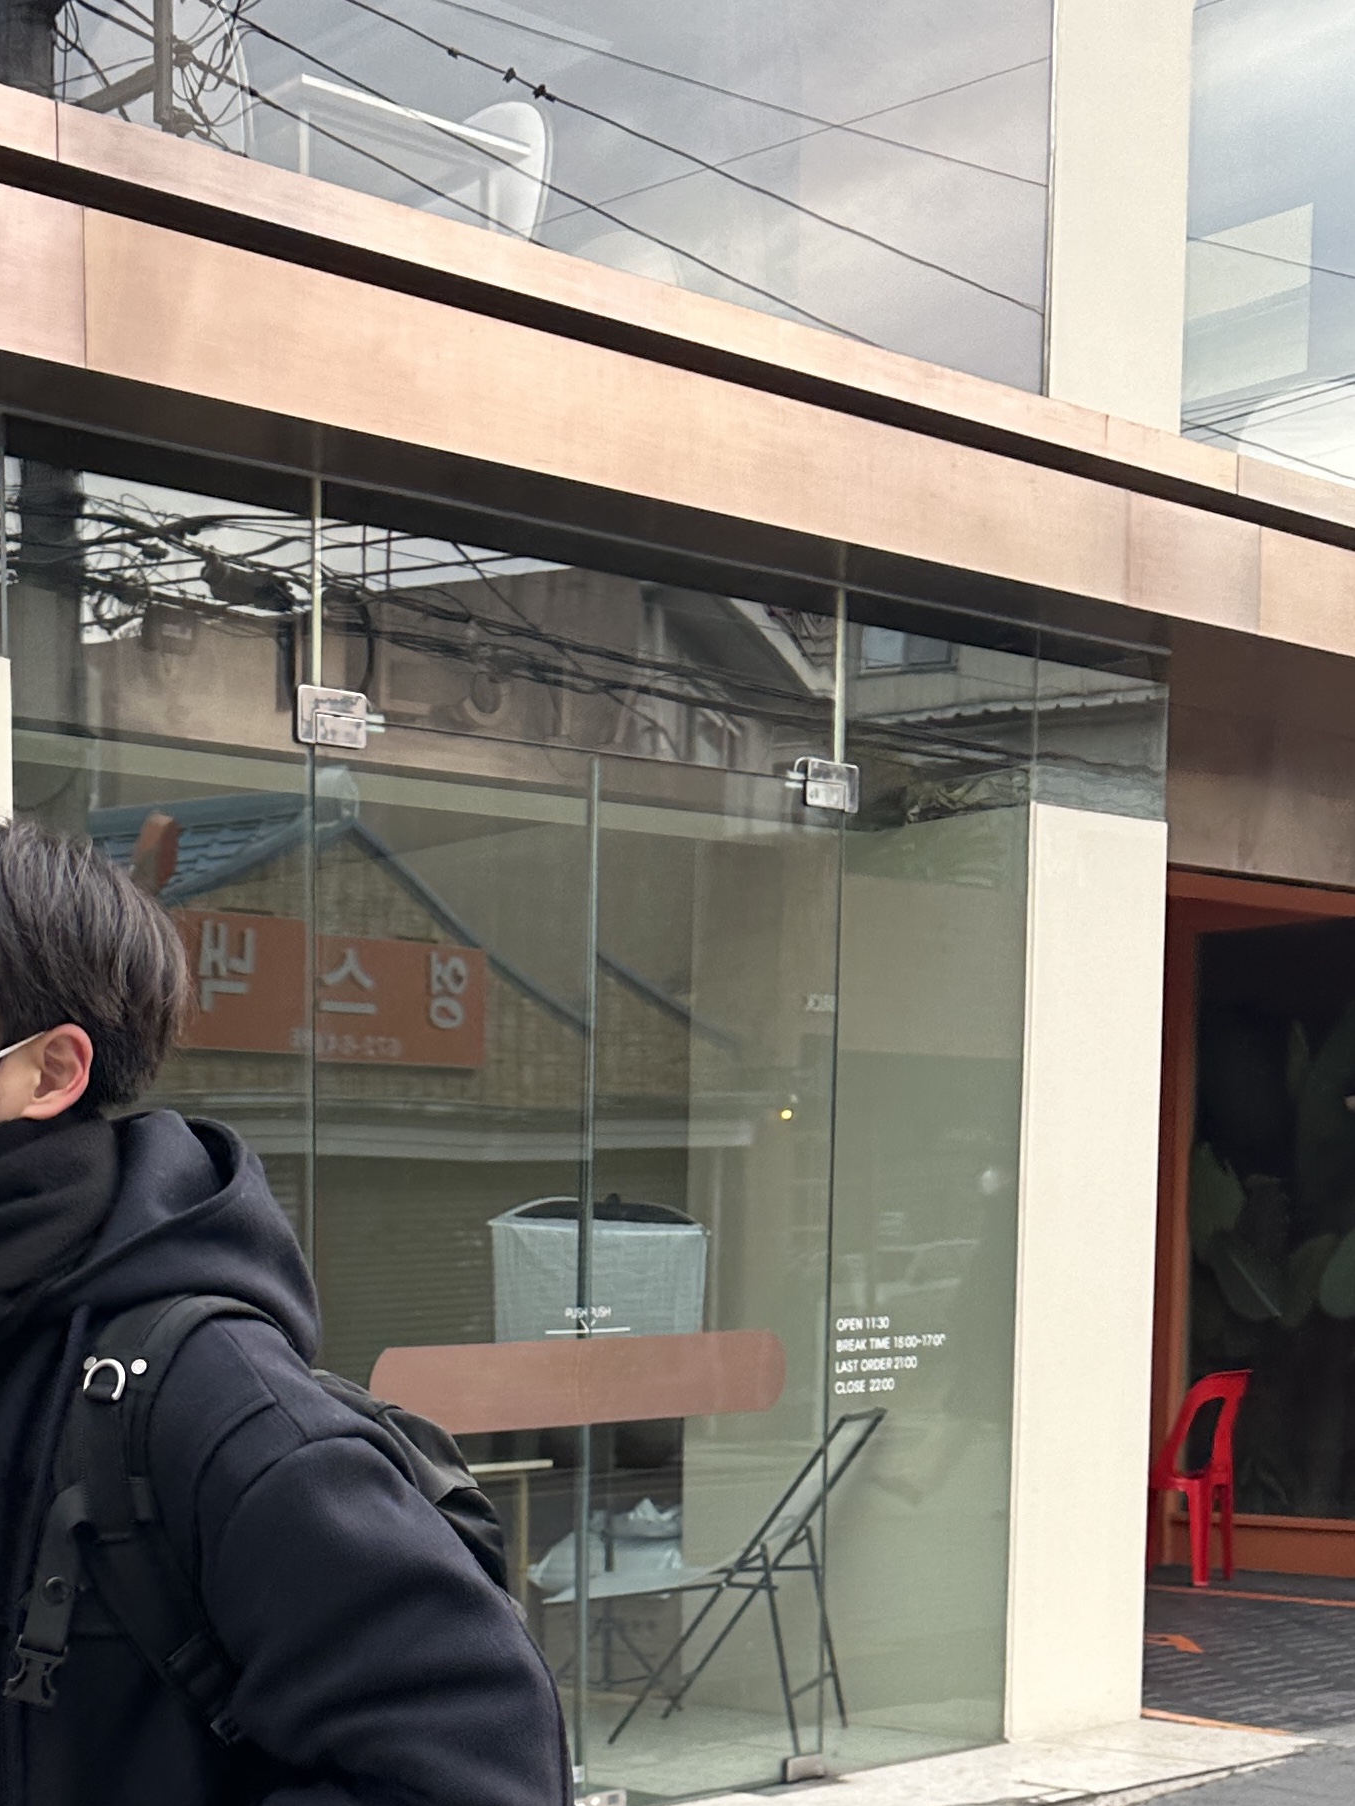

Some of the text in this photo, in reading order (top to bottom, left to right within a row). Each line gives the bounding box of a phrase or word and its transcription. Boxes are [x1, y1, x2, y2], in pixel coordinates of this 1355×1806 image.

[836, 1317, 863, 1331] OPEN
[836, 1338, 867, 1352] BREAK
[869, 1336, 891, 1350] TIME
[835, 1359, 859, 1374] LAST
[860, 1357, 893, 1372] ORDER
[834, 1379, 866, 1395] CLOSE
